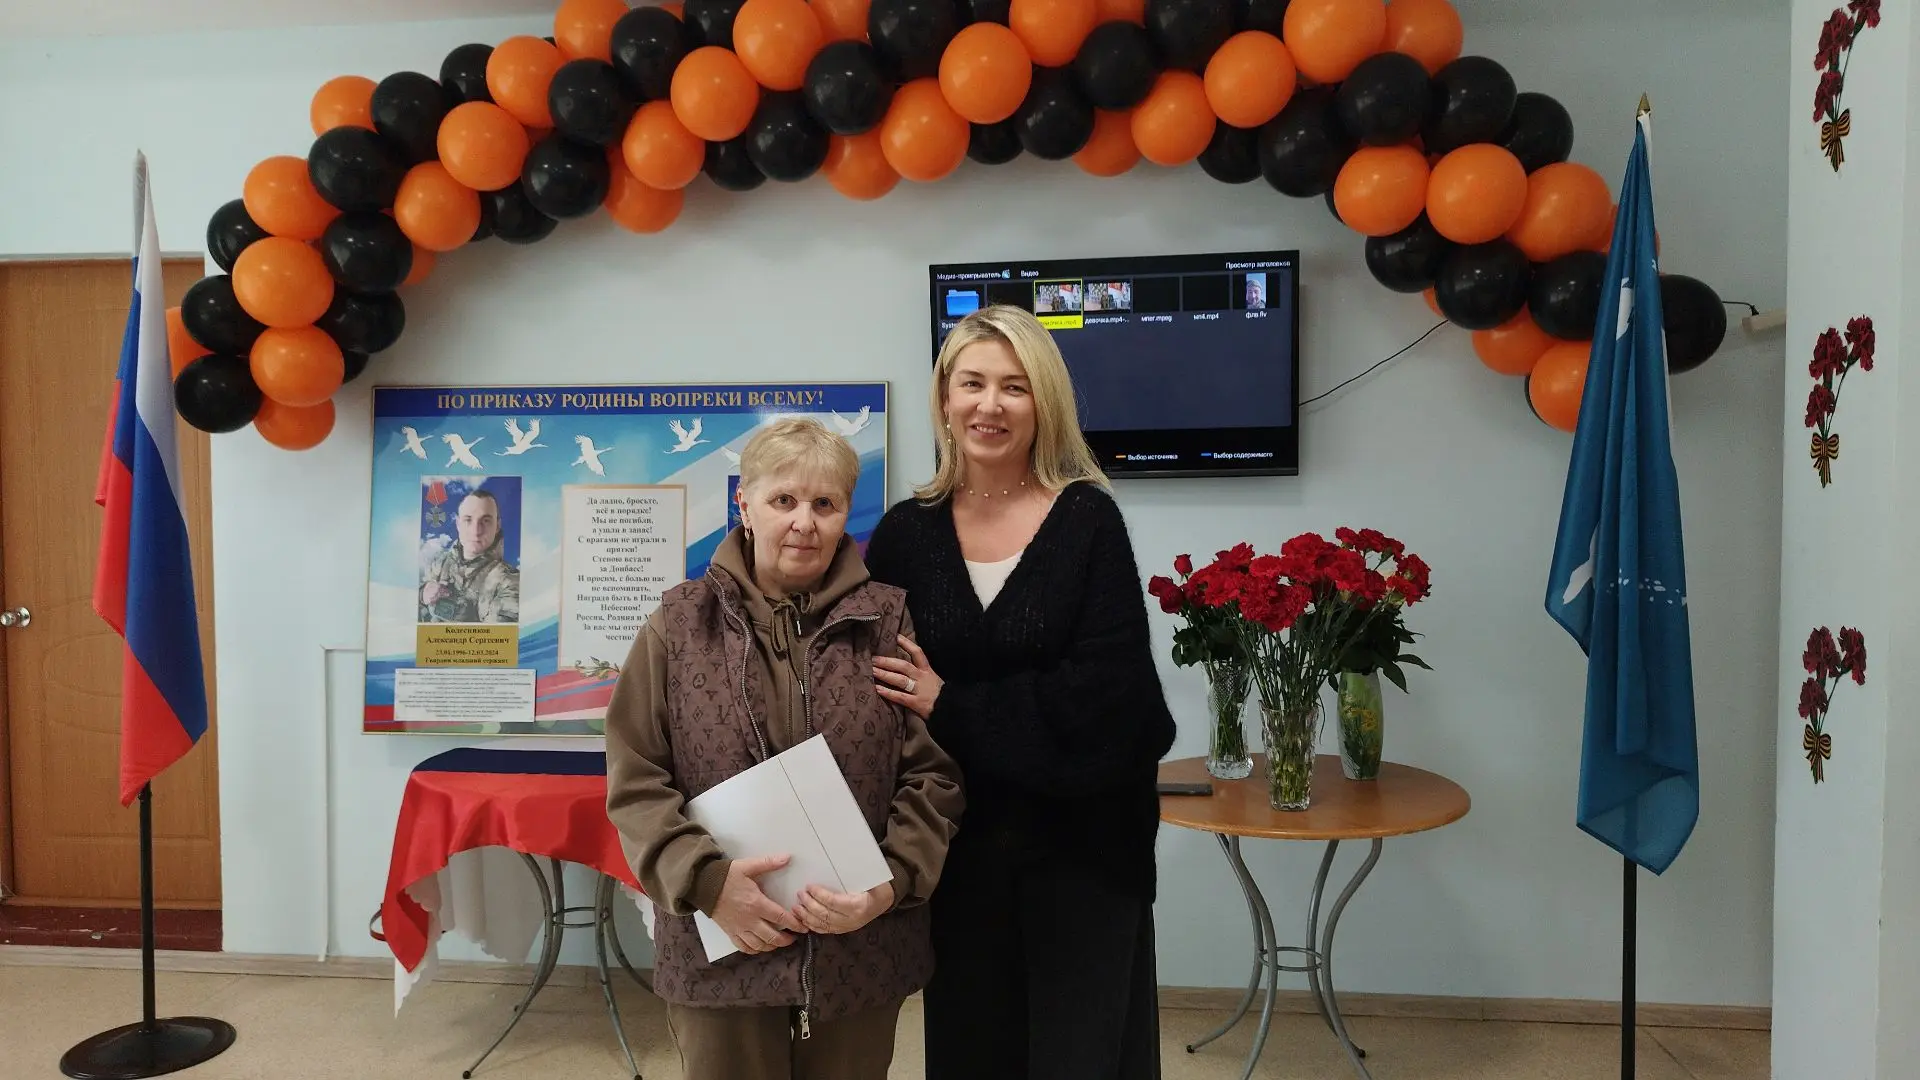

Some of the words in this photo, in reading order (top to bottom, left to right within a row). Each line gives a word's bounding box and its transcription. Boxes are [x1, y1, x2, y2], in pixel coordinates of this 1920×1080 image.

[437, 394, 465, 408] ПО
[469, 394, 556, 408] ПРИКАЗУ
[561, 393, 644, 410] РОДИНЫ
[650, 392, 742, 407] ВОПРЕКИ
[748, 390, 823, 406] ВСЕМУ!
[586, 497, 598, 505] Да
[626, 497, 658, 506] бросьте,
[617, 507, 652, 515] порядке!
[606, 546, 638, 554] прятки!
